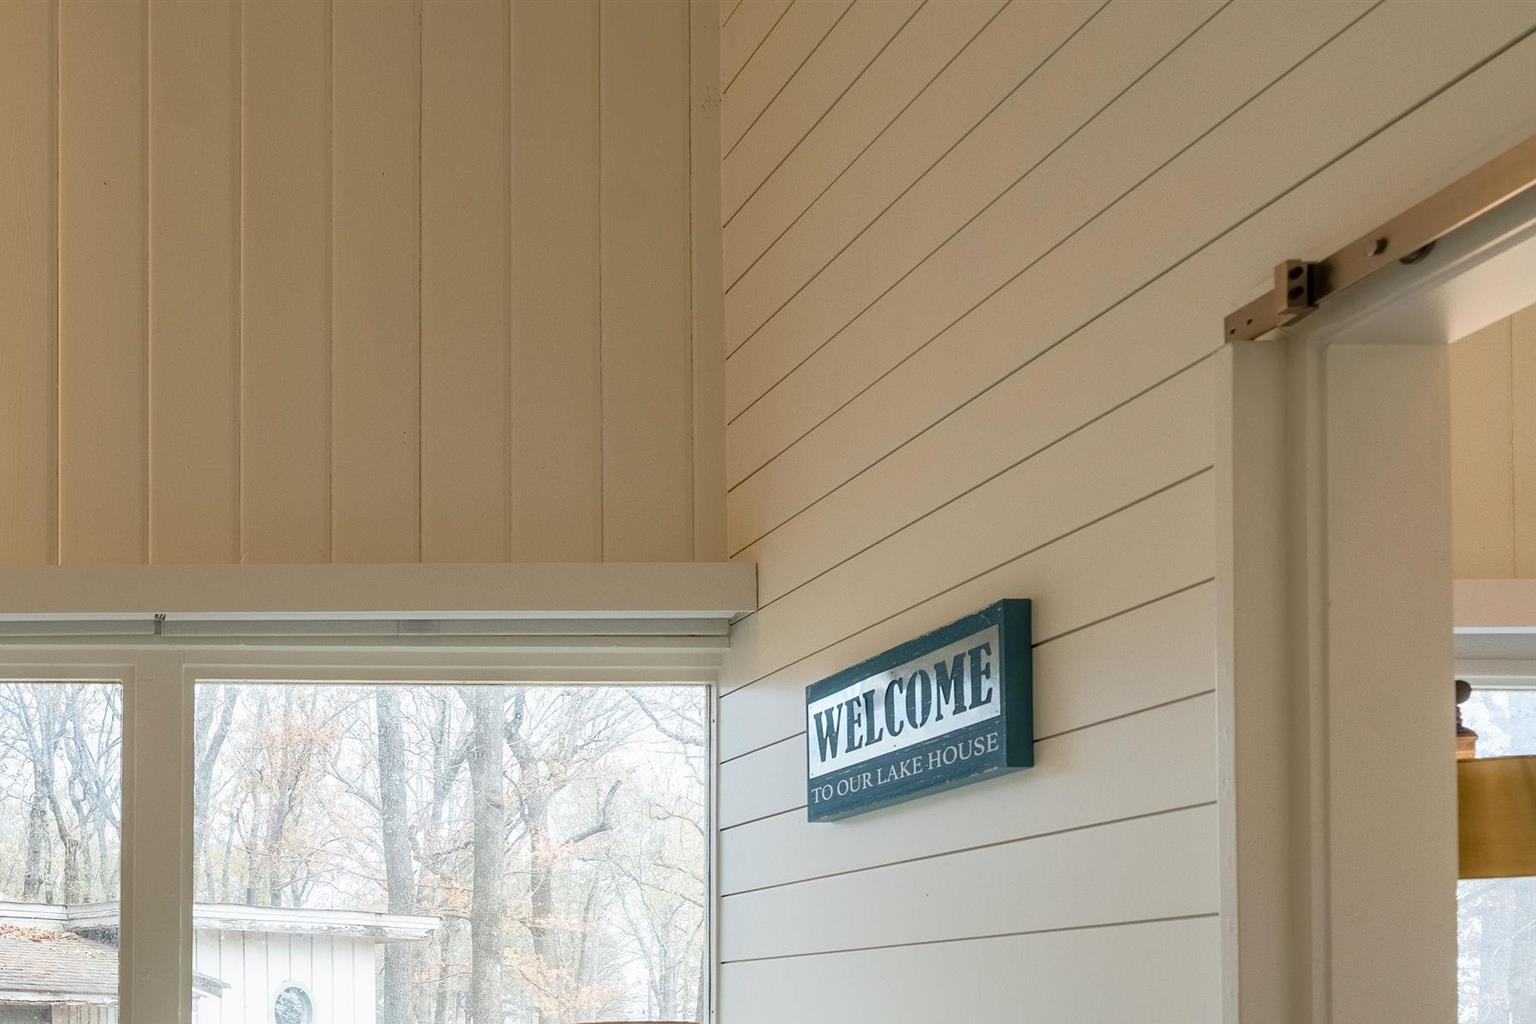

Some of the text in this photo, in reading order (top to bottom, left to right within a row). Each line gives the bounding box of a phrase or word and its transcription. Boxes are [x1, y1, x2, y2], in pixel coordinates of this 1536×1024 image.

[813, 642, 992, 763] WELCOME
[811, 732, 1000, 804] TO OUR LAKE HOUSE
